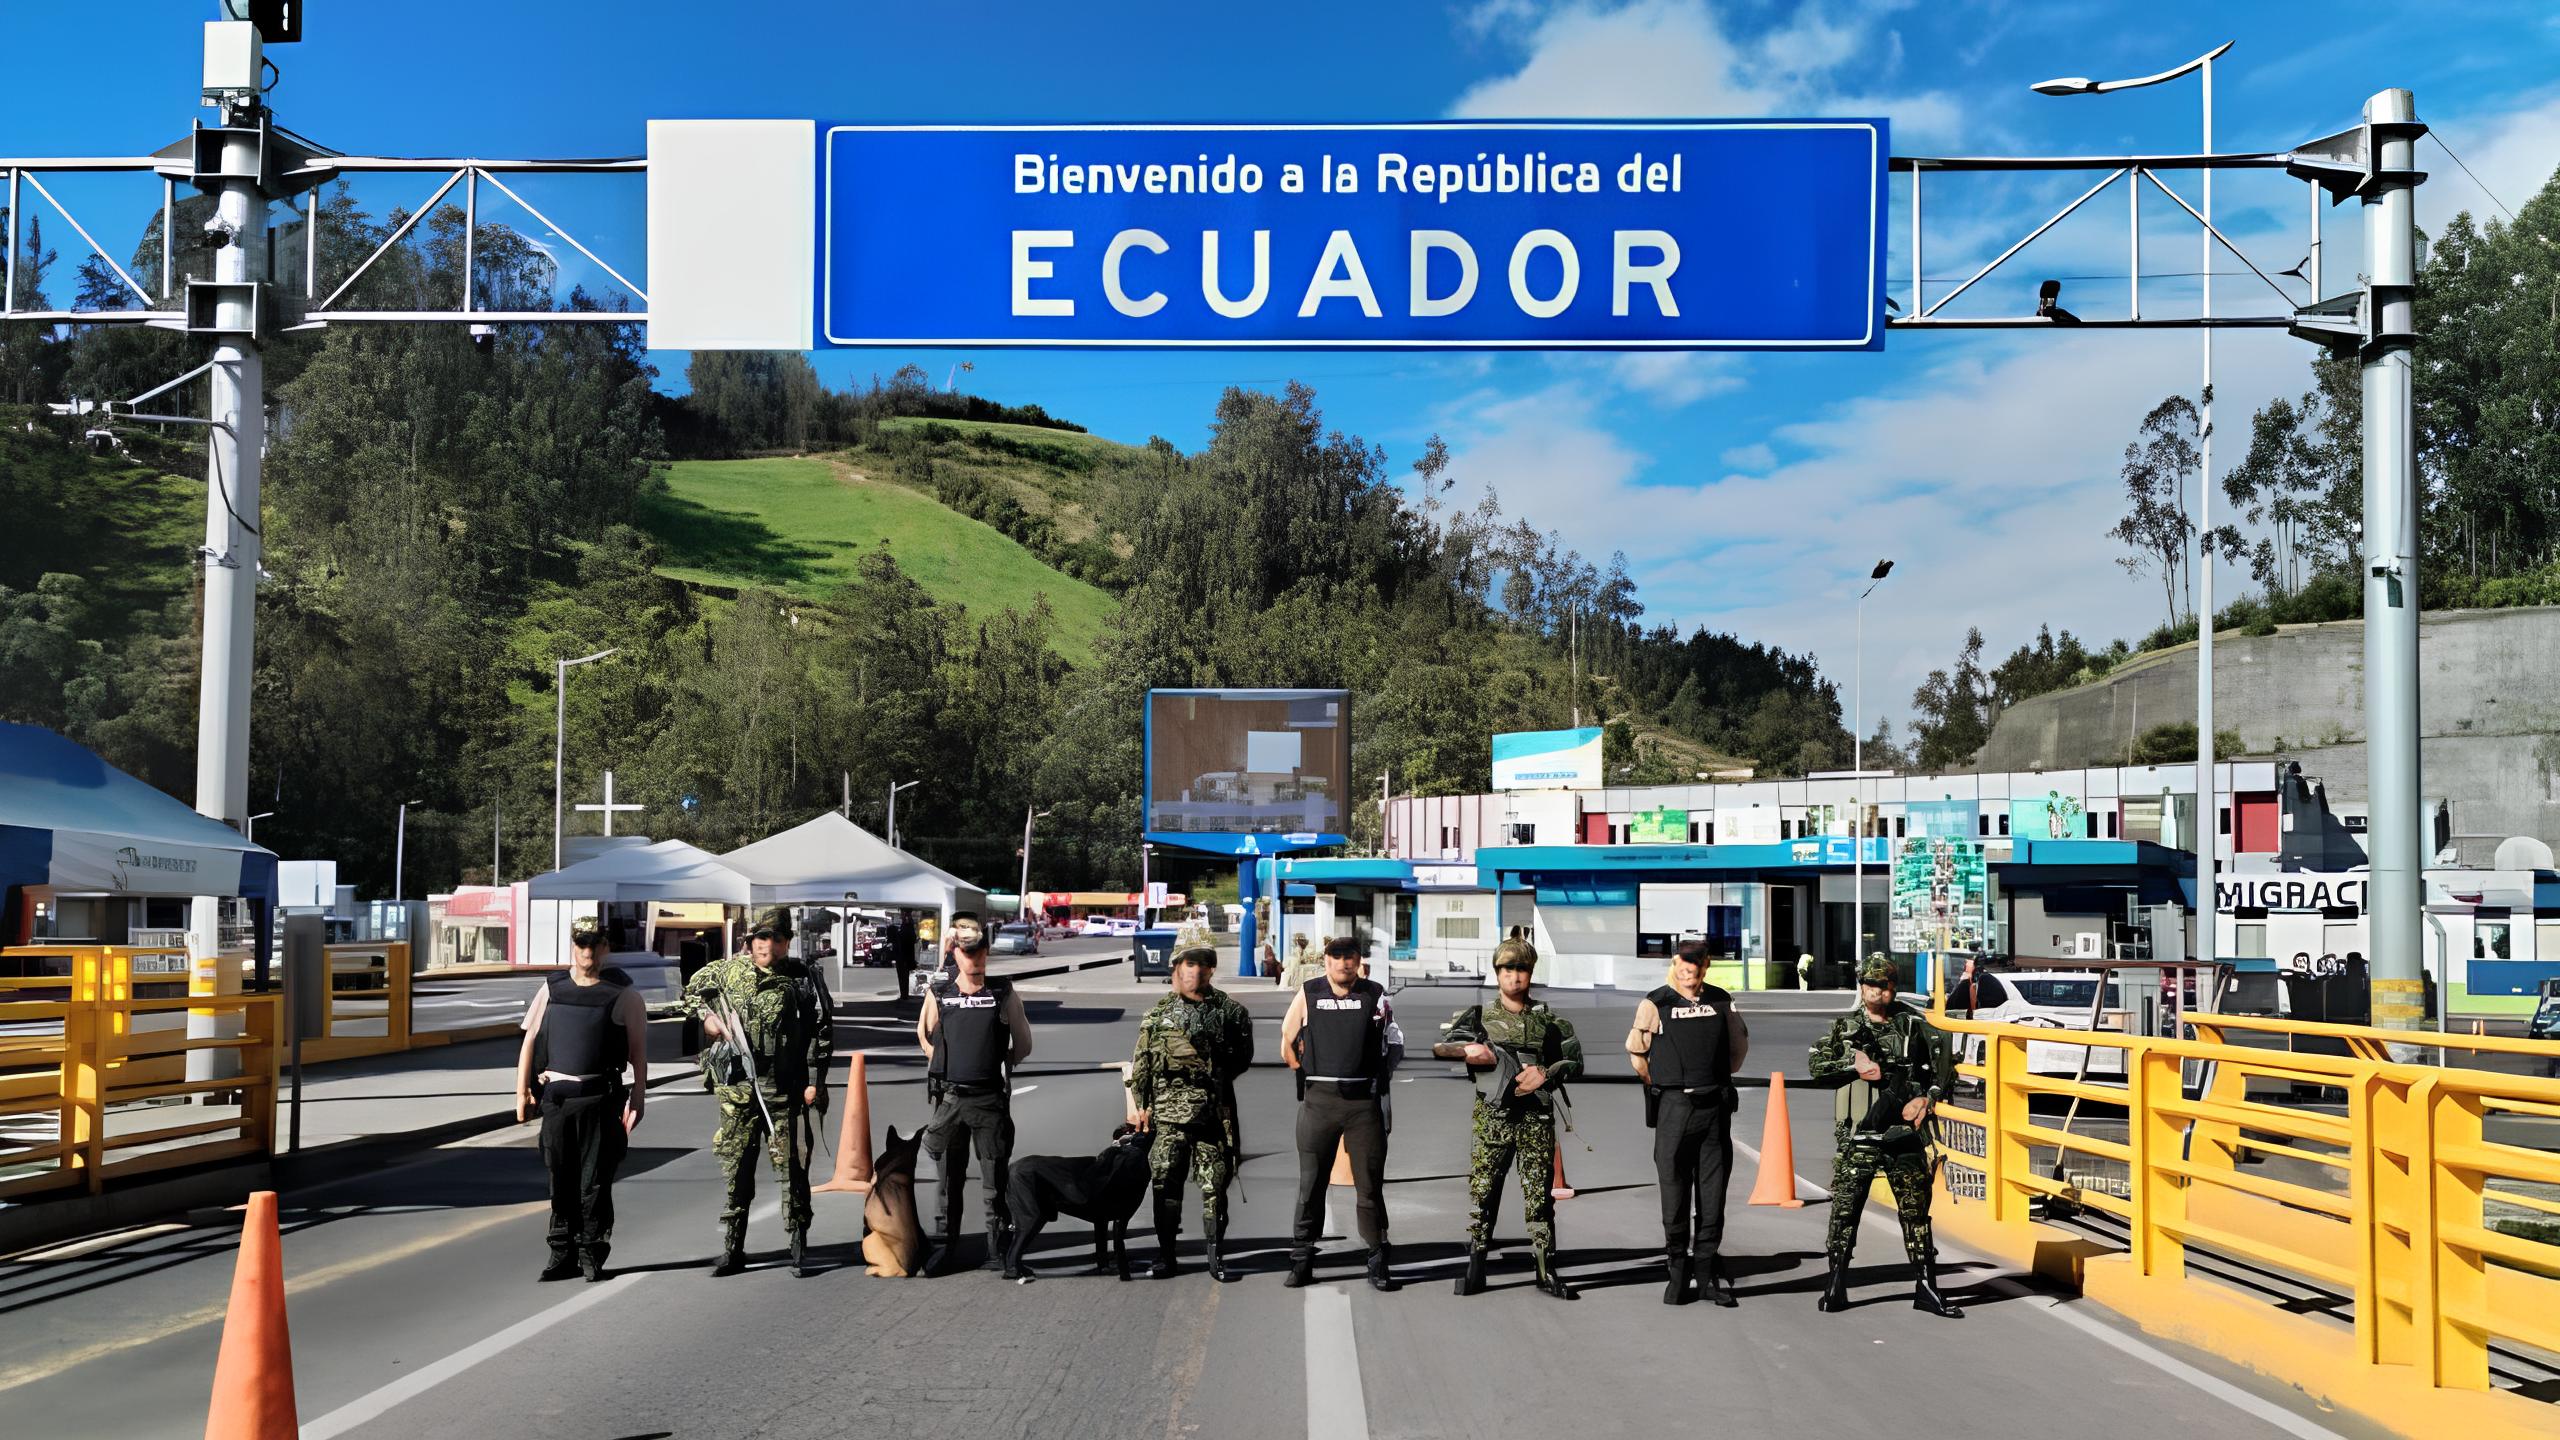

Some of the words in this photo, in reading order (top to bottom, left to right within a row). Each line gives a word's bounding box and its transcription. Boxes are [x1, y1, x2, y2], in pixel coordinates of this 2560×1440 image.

[1014, 153, 1263, 194] Bienvenido
[1280, 164, 1304, 193] a
[1322, 154, 1358, 193] la
[1377, 151, 1600, 204] República
[1617, 152, 1683, 193] del
[1011, 228, 1681, 319] ECUADOR
[2215, 881, 2369, 911] MIGRACI
